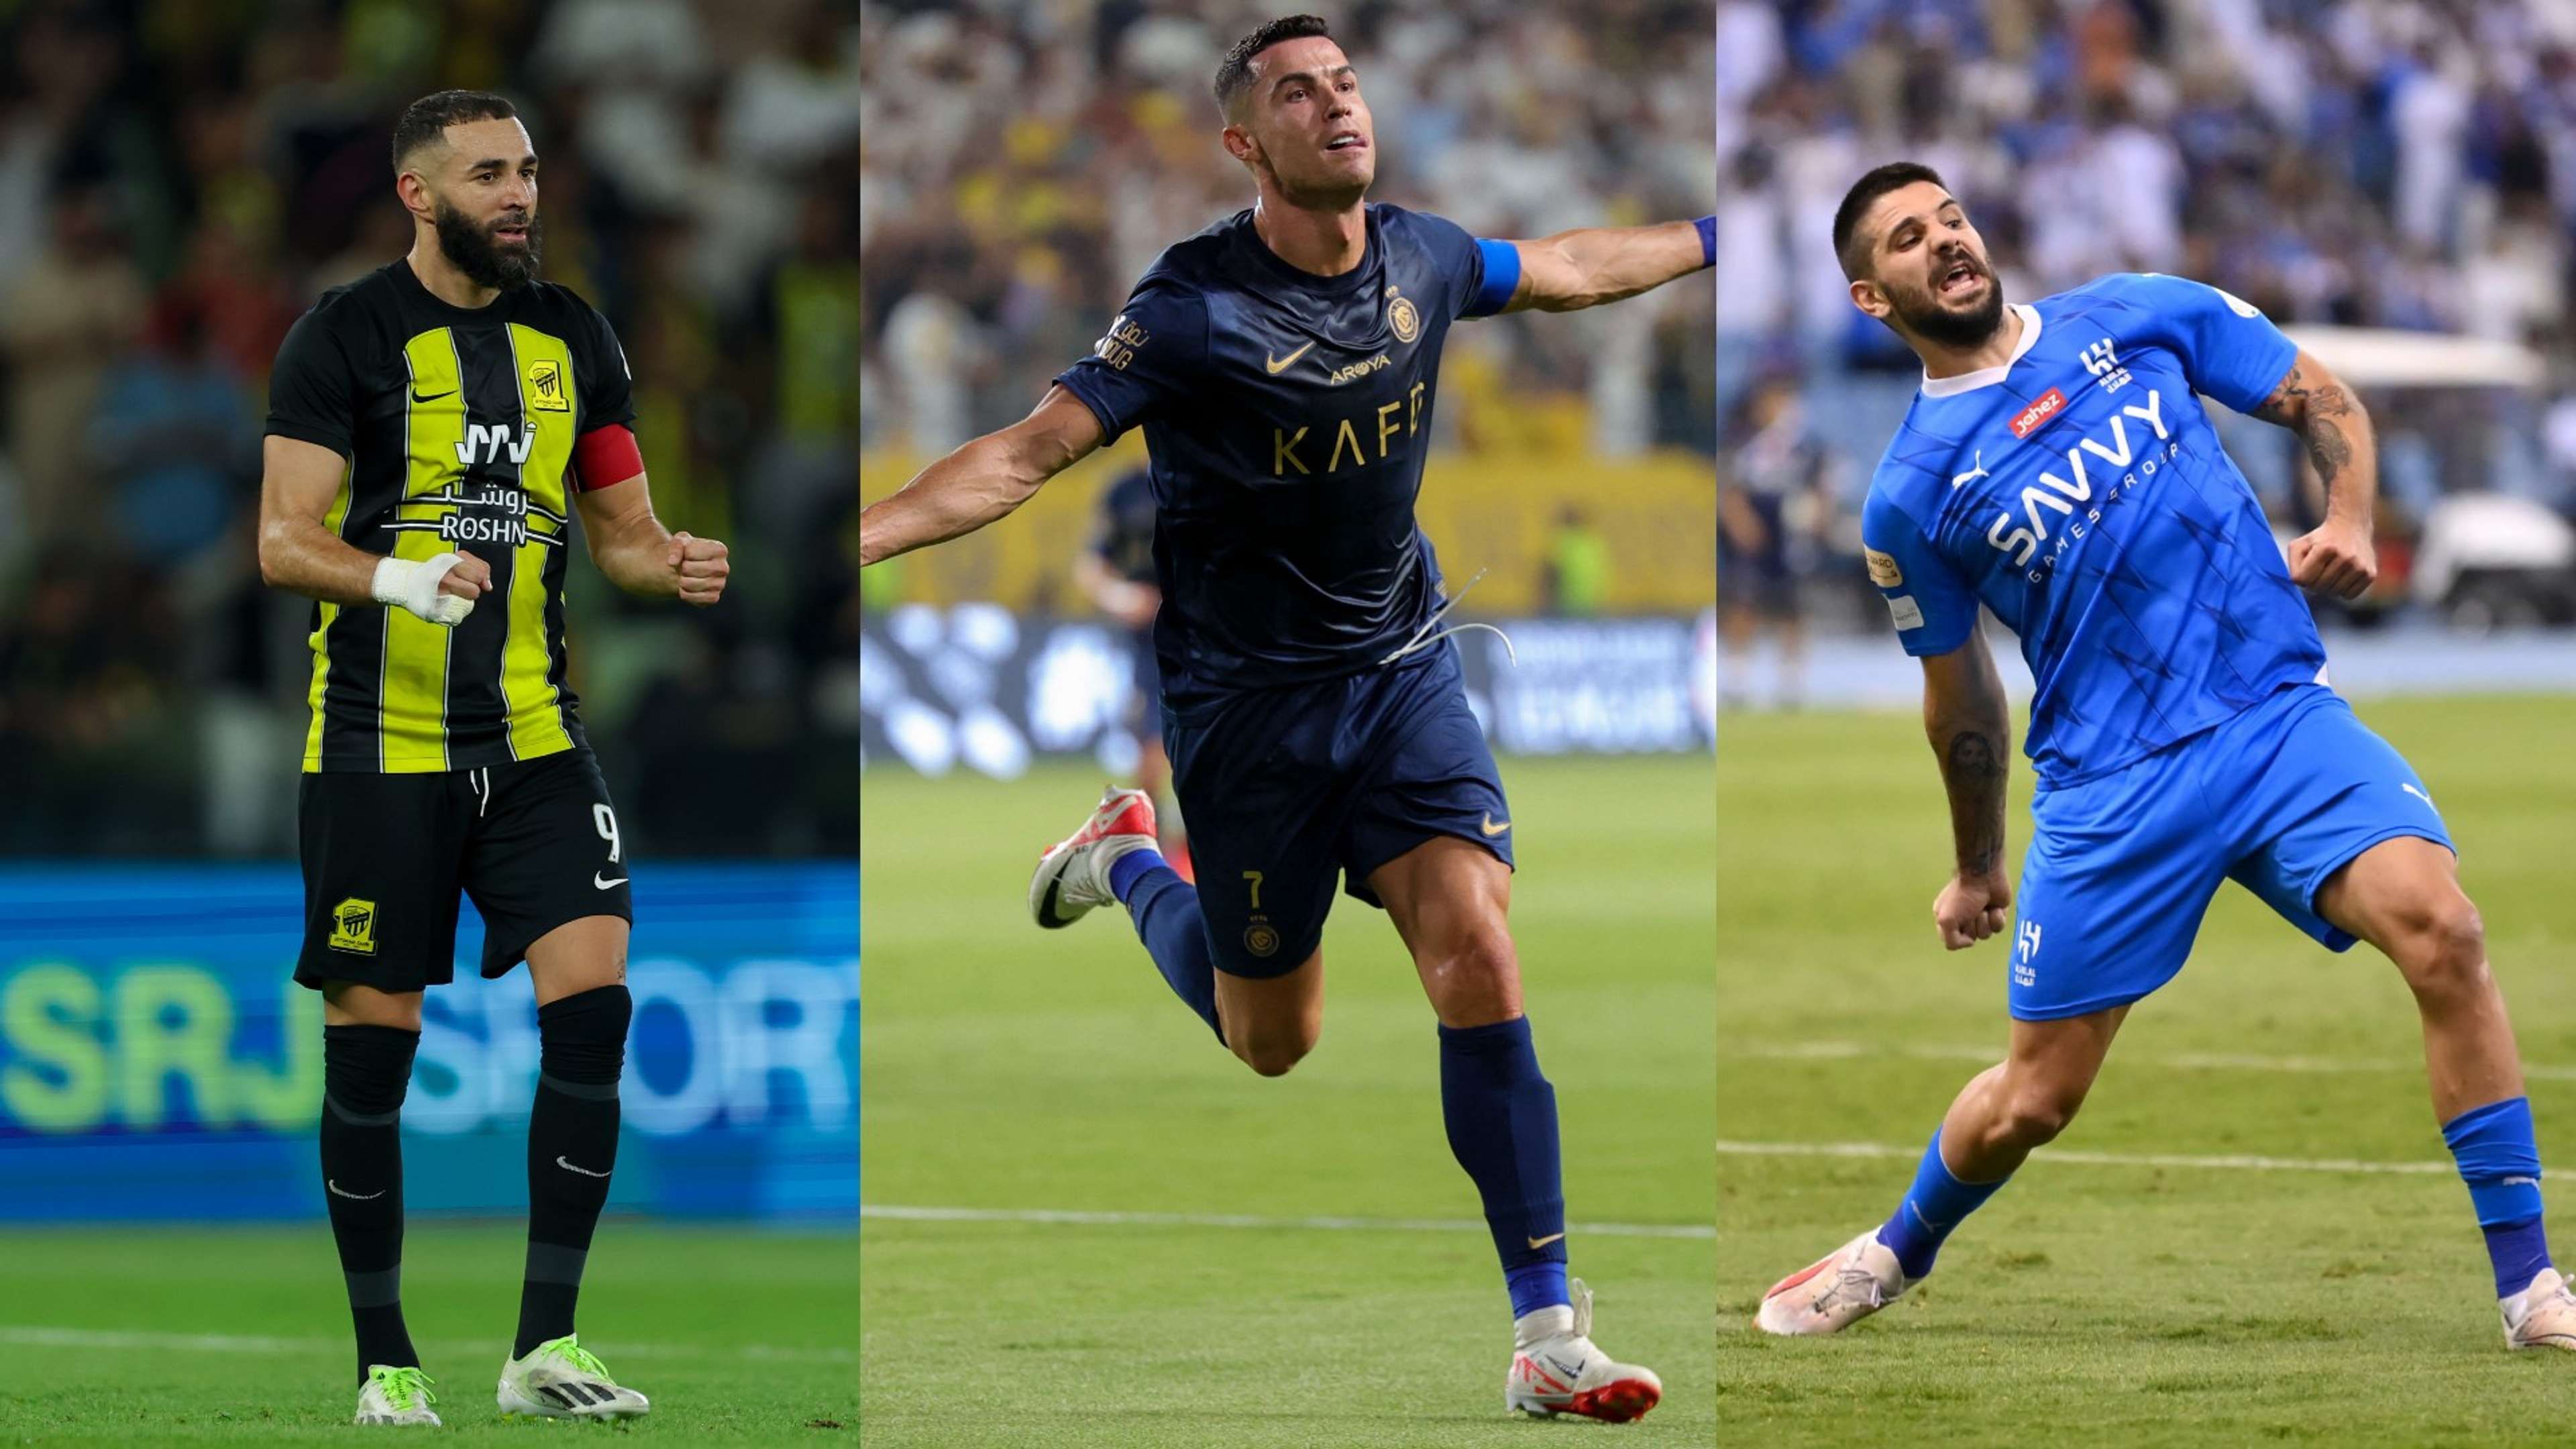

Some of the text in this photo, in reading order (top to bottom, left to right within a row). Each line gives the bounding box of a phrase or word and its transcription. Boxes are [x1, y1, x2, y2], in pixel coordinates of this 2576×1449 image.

[1330, 354, 1392, 385] AROYA
[1988, 390, 2168, 567] SAVVY
[442, 515, 527, 545] ROSHN
[2028, 443, 2179, 584] GAMES GROUP
[593, 803, 621, 864] 9
[1243, 871, 1263, 909] 7
